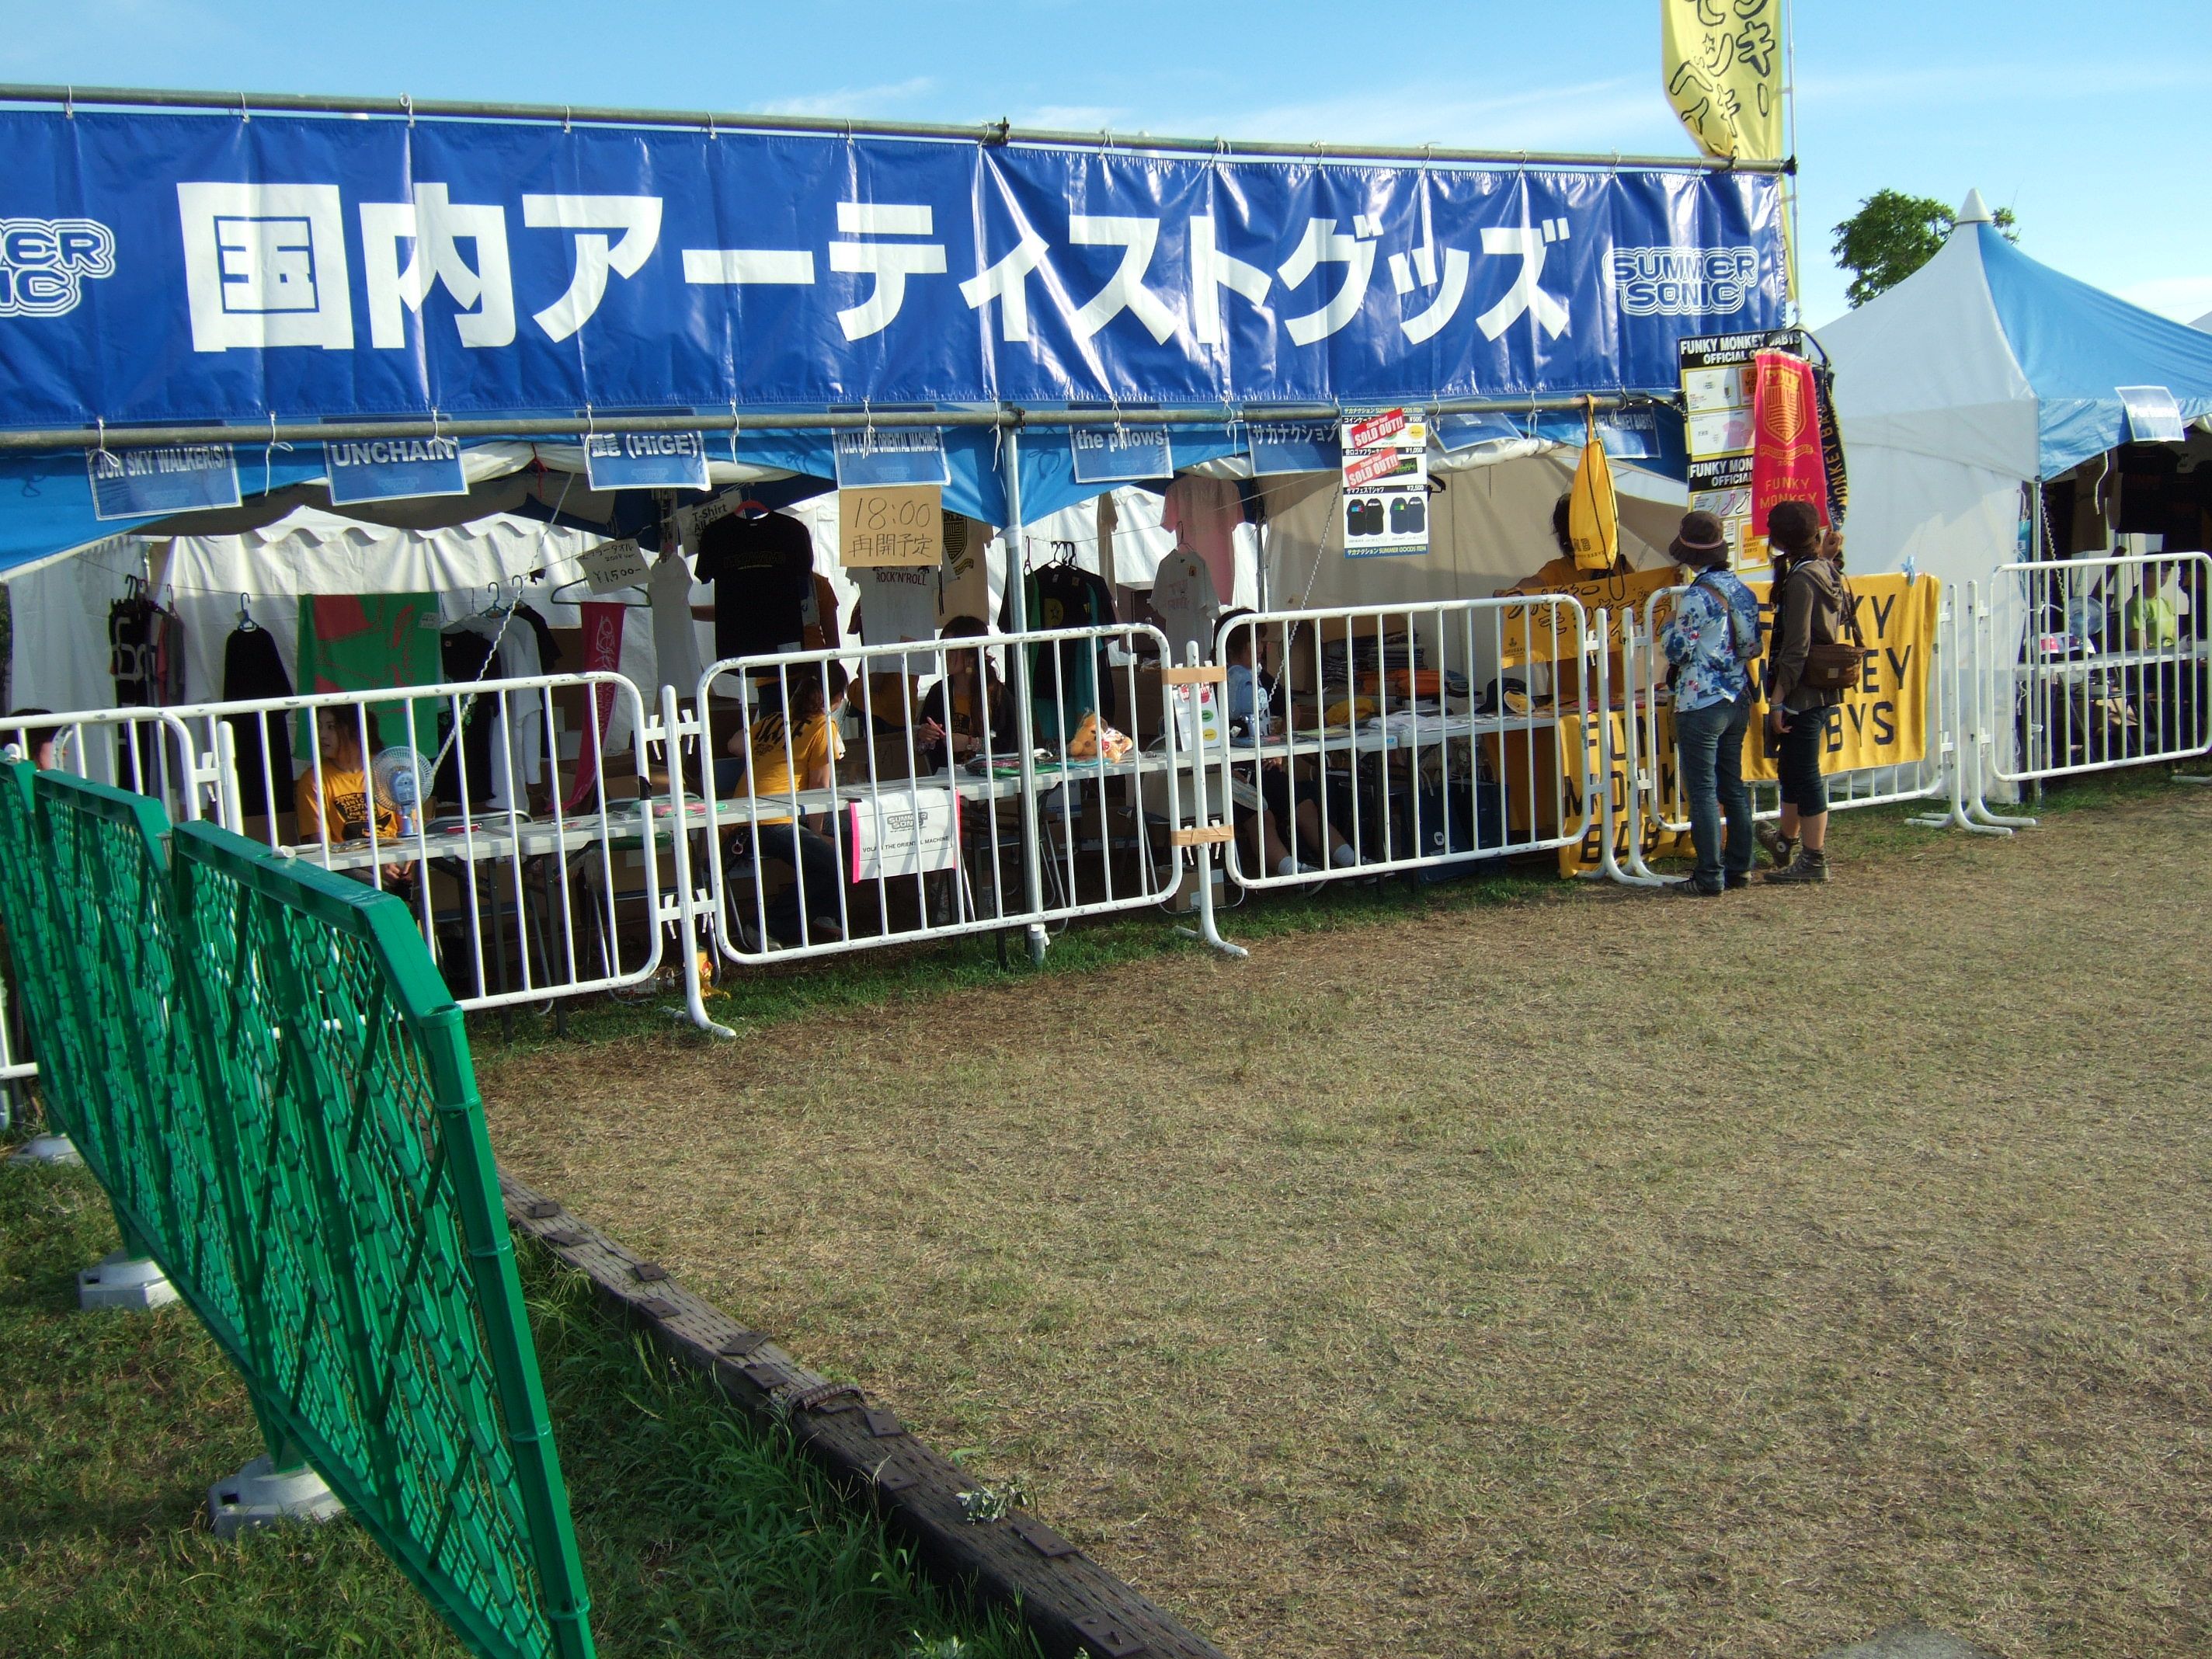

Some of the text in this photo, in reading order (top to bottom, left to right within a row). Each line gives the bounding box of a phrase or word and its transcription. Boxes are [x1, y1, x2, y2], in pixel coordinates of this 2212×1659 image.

[176, 181, 1571, 353] 国内アーティストグッズ
[1608, 252, 1758, 283] SUMMER
[1622, 282, 1743, 311] SONIC
[1680, 332, 1801, 355] FUNKY MONKEY ABYS
[1702, 350, 1747, 364] OFFICIAL
[1076, 430, 1104, 450] the
[1253, 423, 1341, 445] サカナクション
[1354, 417, 1404, 447] SOLD OUT!!
[331, 439, 456, 468] UNCHAIN
[625, 432, 698, 460] (HiGE)
[127, 450, 153, 476] SKY
[1348, 455, 1399, 487] SOLD OUT!!
[1689, 461, 1726, 478] FUNKY
[1765, 476, 1810, 492] FUNKY
[691, 503, 728, 522] T-Shirt
[854, 497, 931, 530] 18:00
[848, 533, 934, 558] 再開予定
[875, 571, 928, 586] ROCK'N'ROLL
[1758, 593, 1897, 639] FKY
[1747, 645, 1912, 704] MEY
[1763, 701, 1896, 759] BYS
[897, 840, 924, 848] ORIENTL
[924, 836, 950, 845] MACHINE
